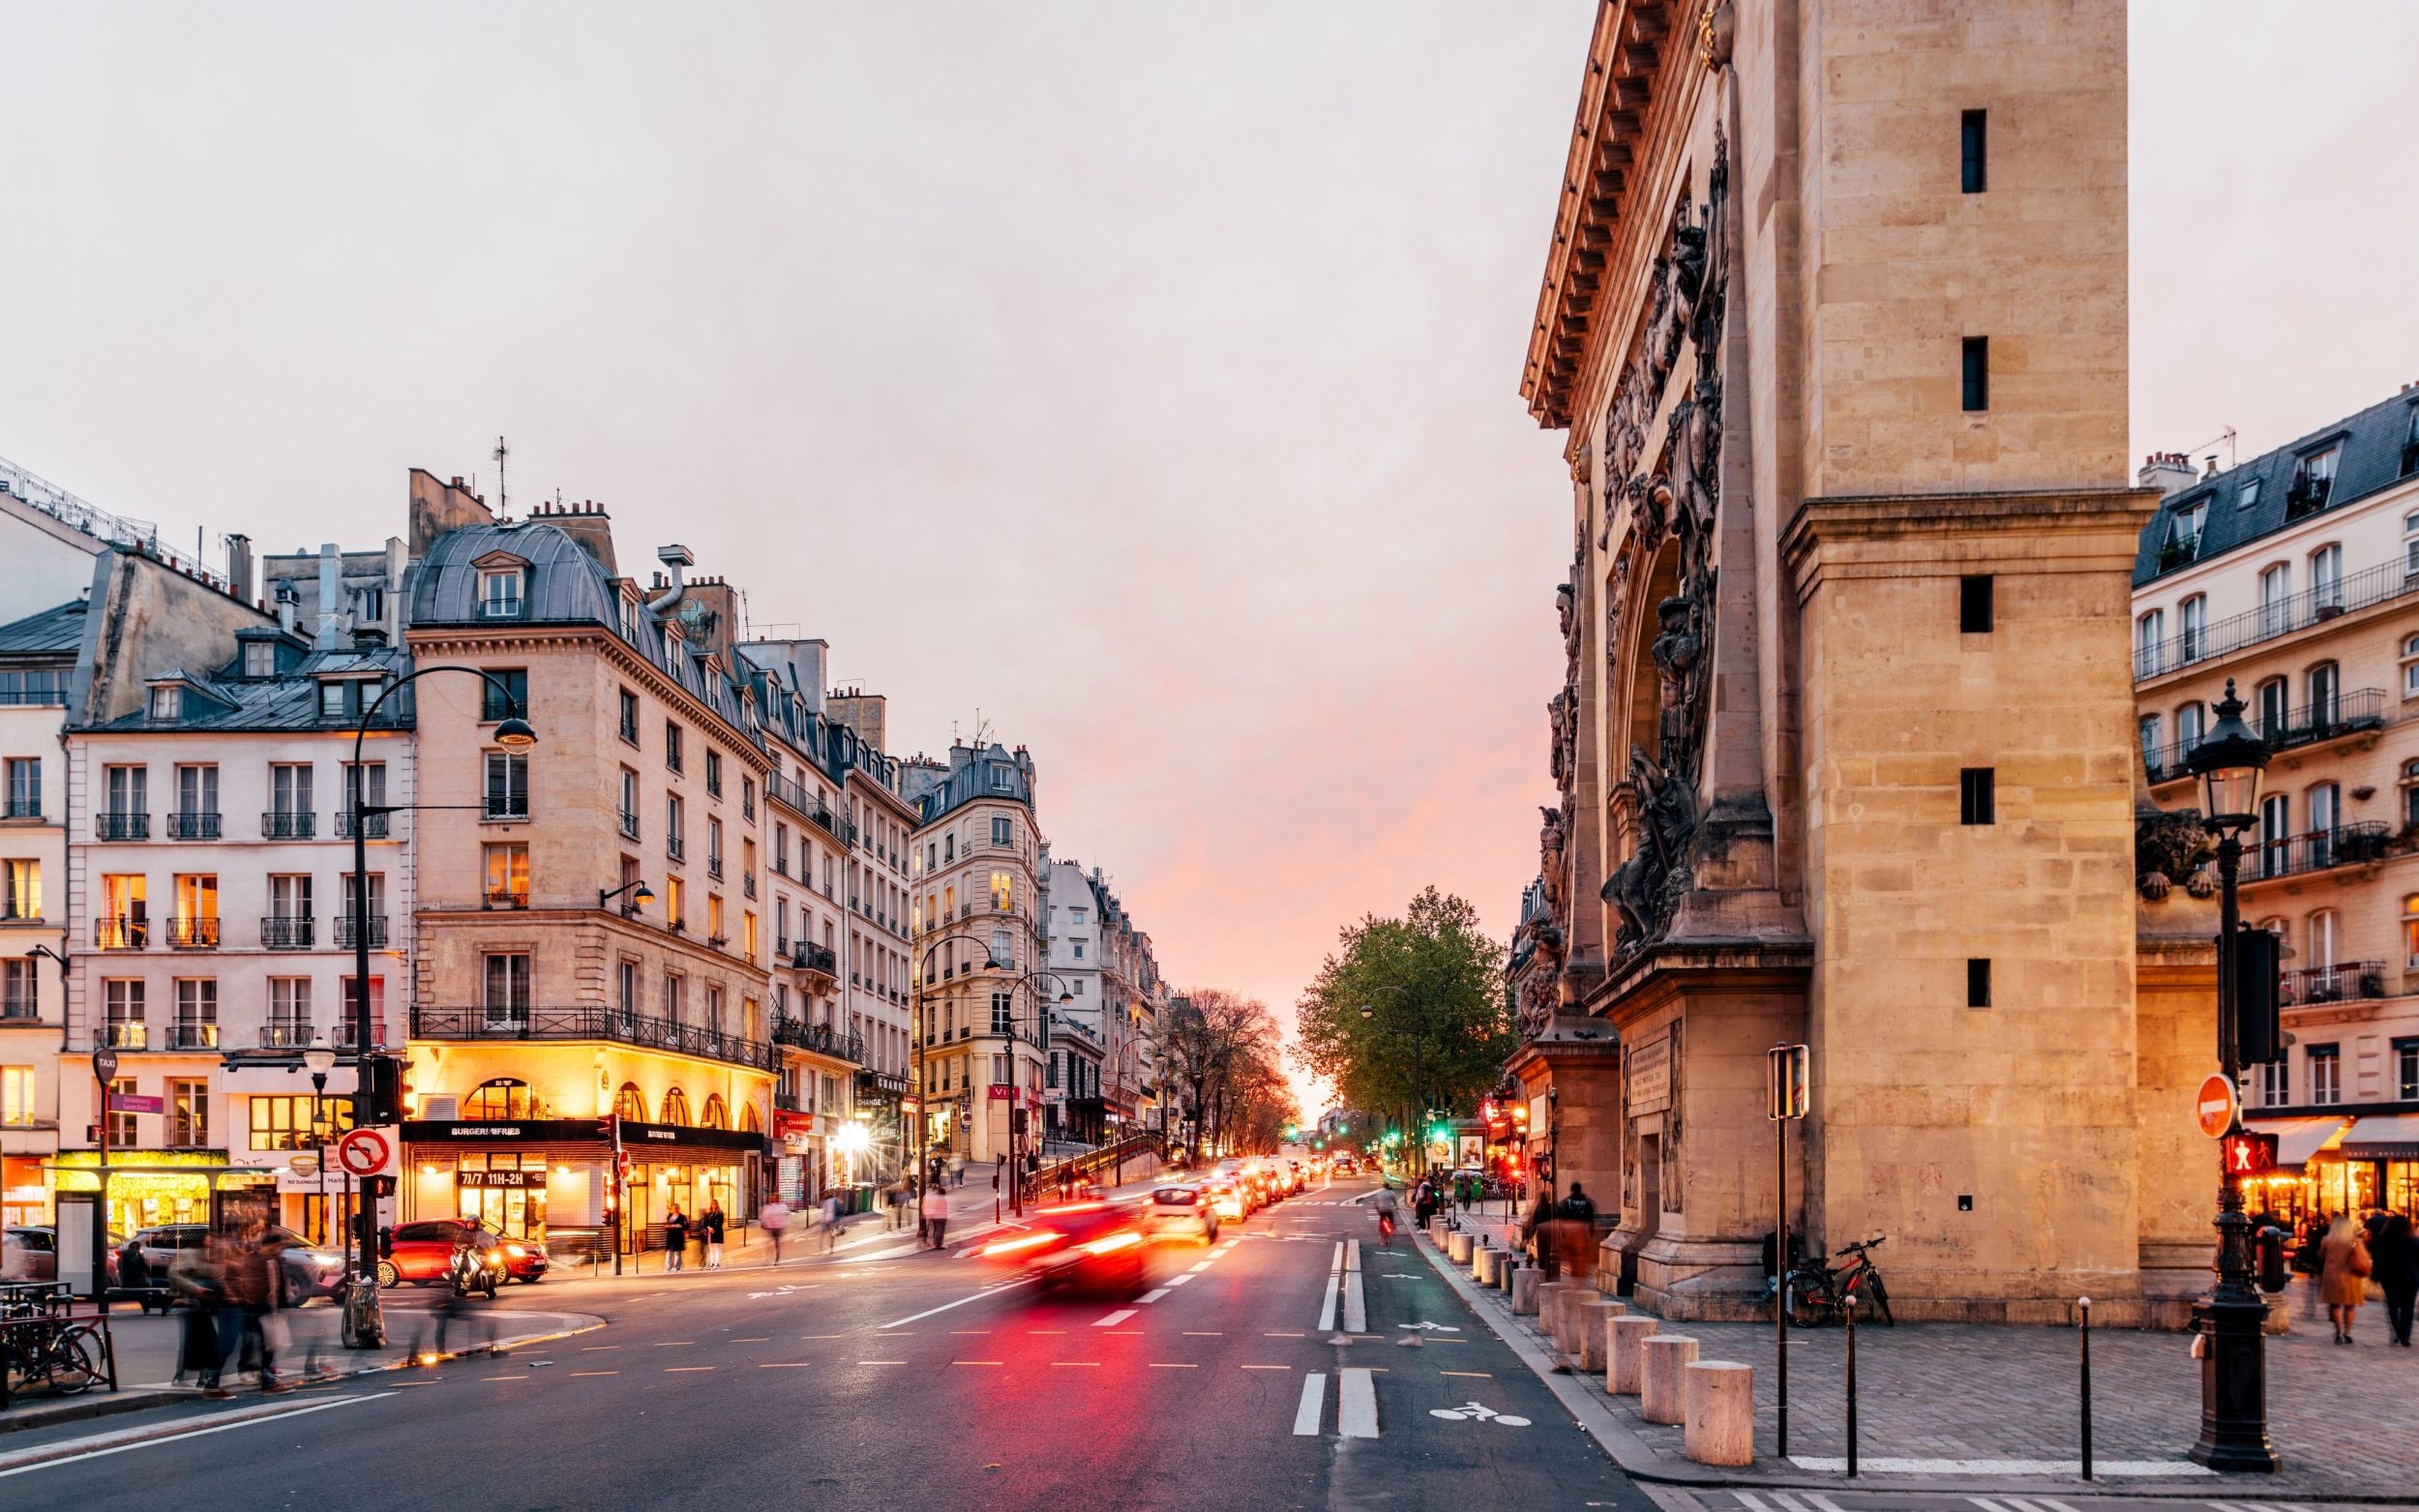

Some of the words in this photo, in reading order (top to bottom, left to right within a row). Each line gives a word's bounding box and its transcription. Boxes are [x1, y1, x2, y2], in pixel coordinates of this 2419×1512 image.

[99, 1058, 115, 1068] TAXI
[878, 1077, 908, 1092] CHANGE
[995, 1087, 1015, 1096] VI
[488, 1172, 523, 1185] 11H-2H
